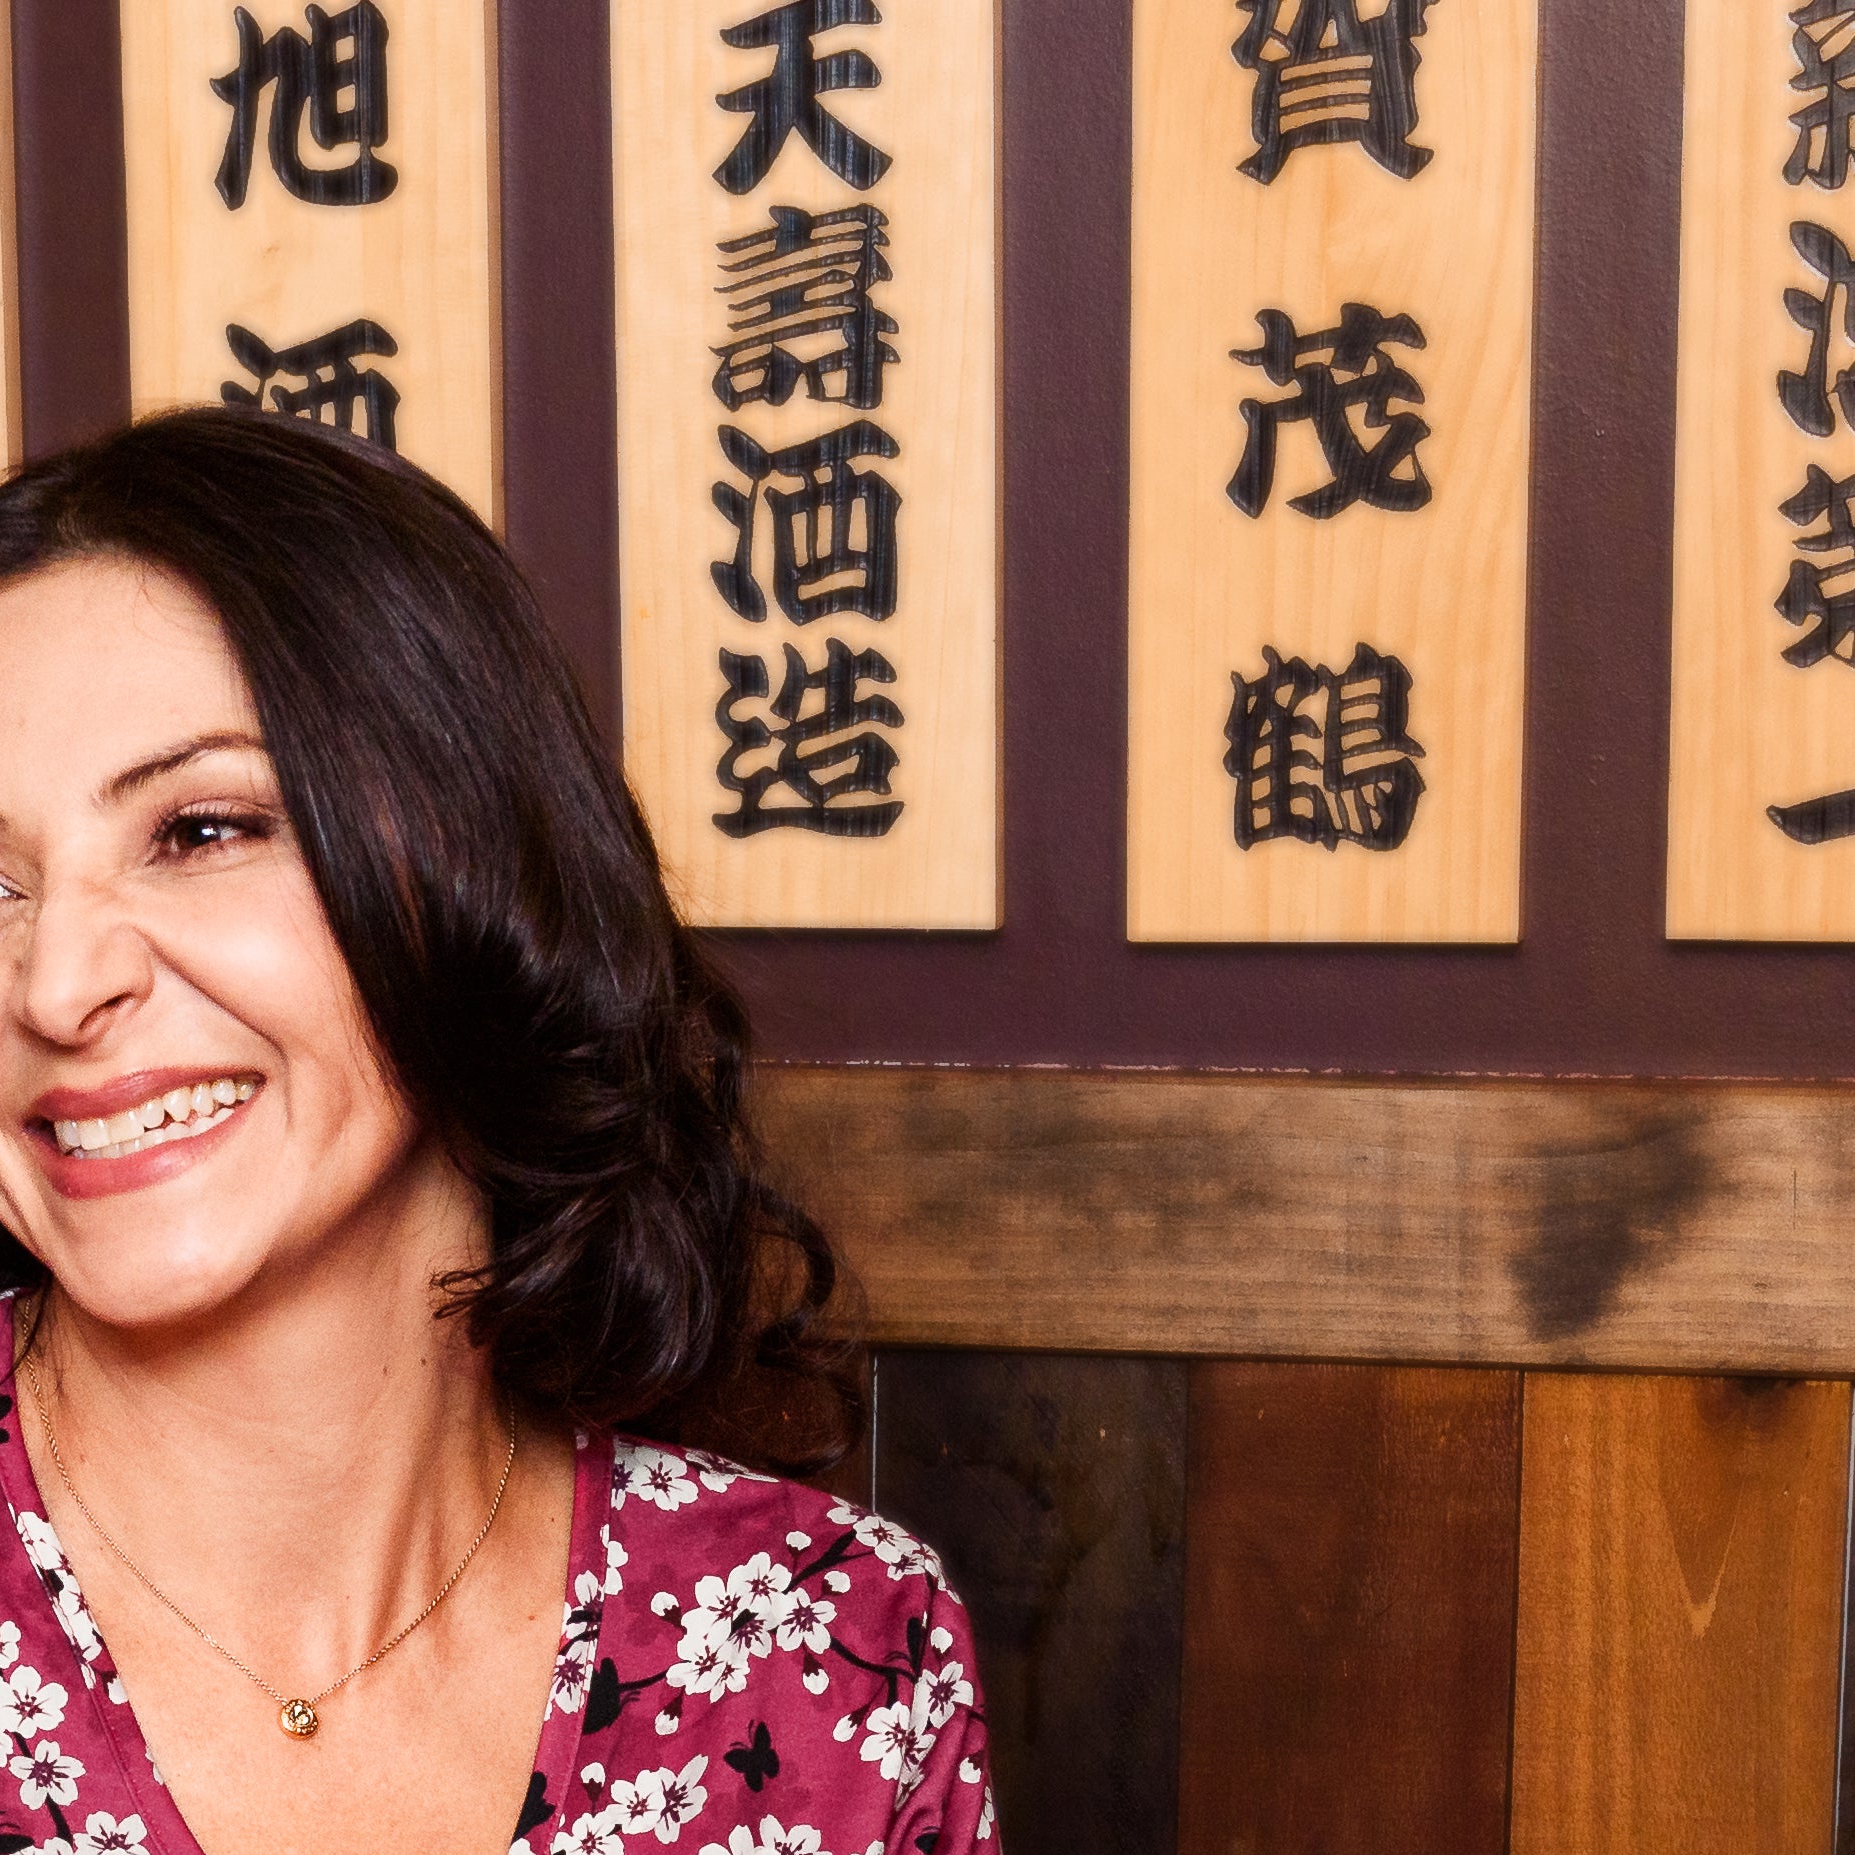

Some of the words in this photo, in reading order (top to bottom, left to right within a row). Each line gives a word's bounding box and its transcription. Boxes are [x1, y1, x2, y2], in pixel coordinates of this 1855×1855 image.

[709, 0, 906, 839] 天壽酒造
[1222, 0, 1439, 852] 賀茂鶴
